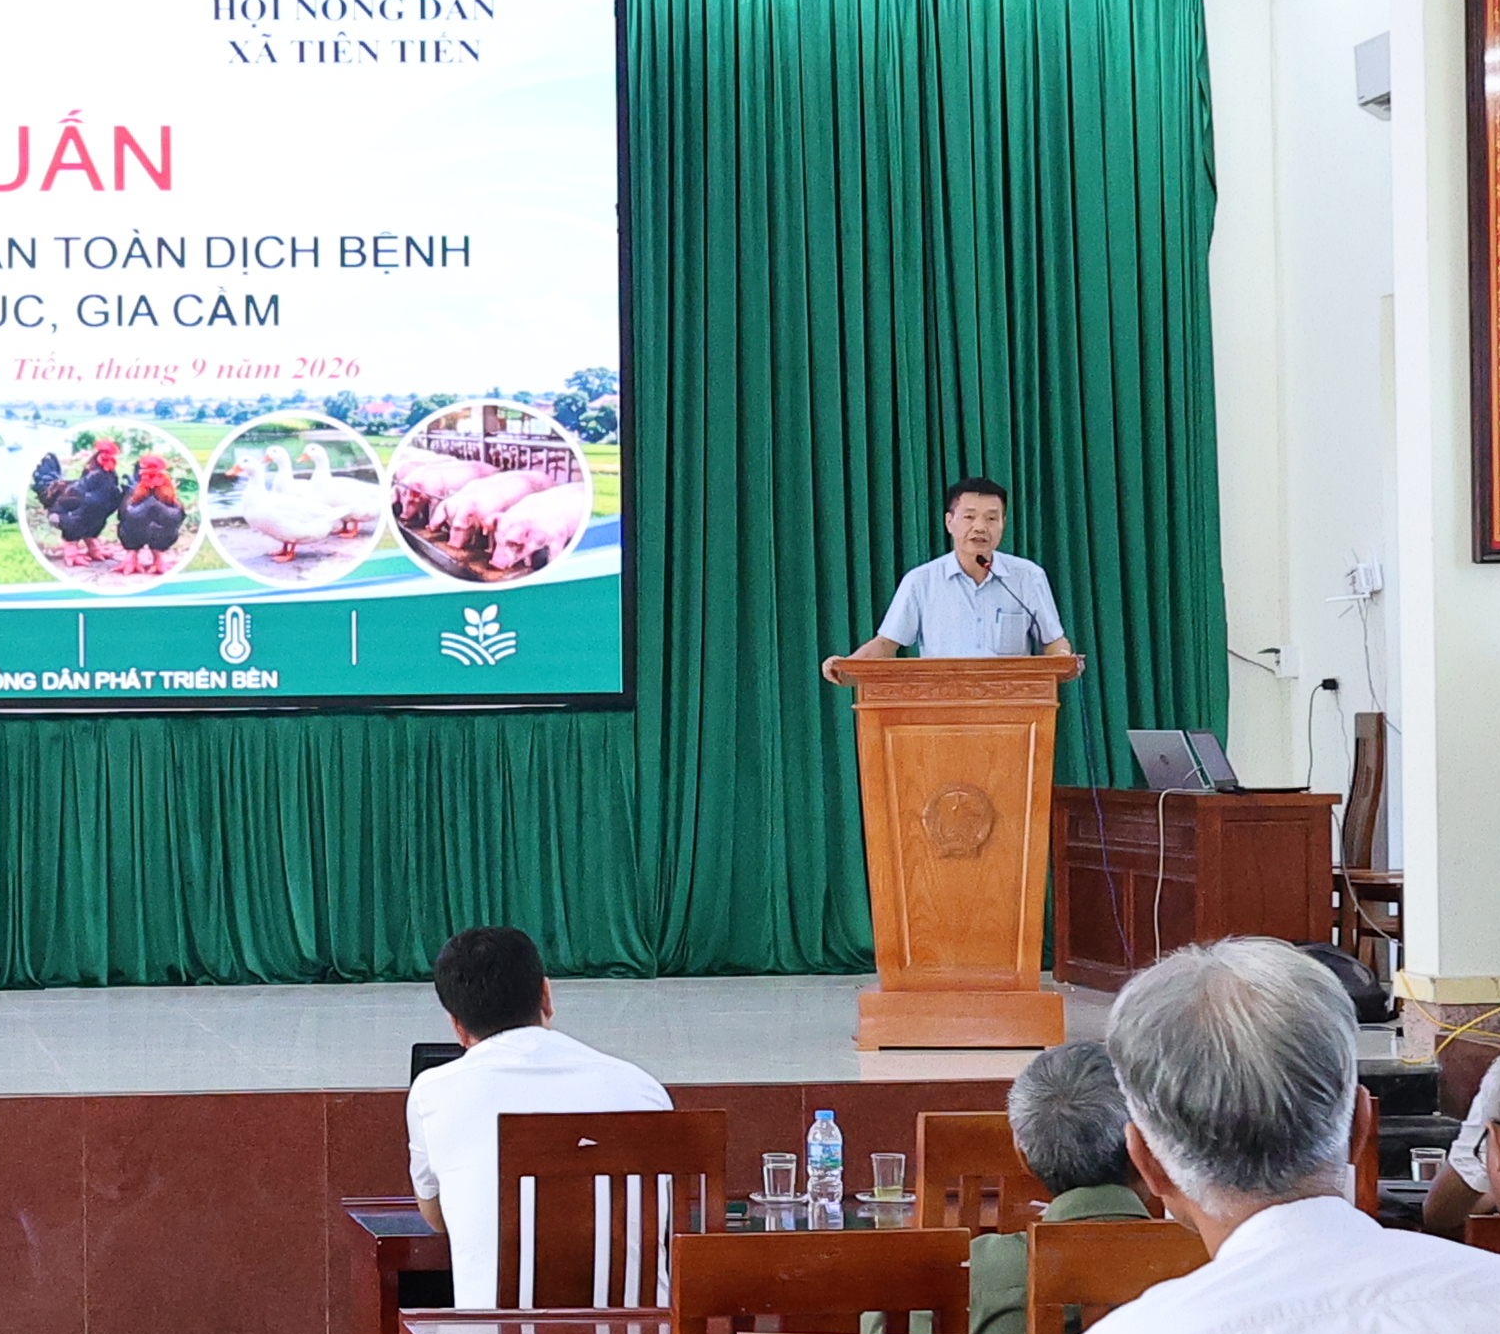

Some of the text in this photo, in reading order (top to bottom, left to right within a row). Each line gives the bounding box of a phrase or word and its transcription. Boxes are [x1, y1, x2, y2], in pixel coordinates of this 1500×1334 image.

[227, 32, 279, 64] XÃ
[290, 31, 381, 64] TIÊN
[53, 228, 187, 270] TOÀN
[205, 236, 320, 276] DỊCH
[339, 231, 471, 276] BỆNH
[76, 294, 159, 328] GIA
[173, 286, 280, 328] CẦM
[13, 351, 83, 385] Tiến,
[94, 357, 180, 386] tháng
[191, 357, 207, 380] 9
[216, 357, 282, 380] năm
[290, 357, 361, 380] 2026
